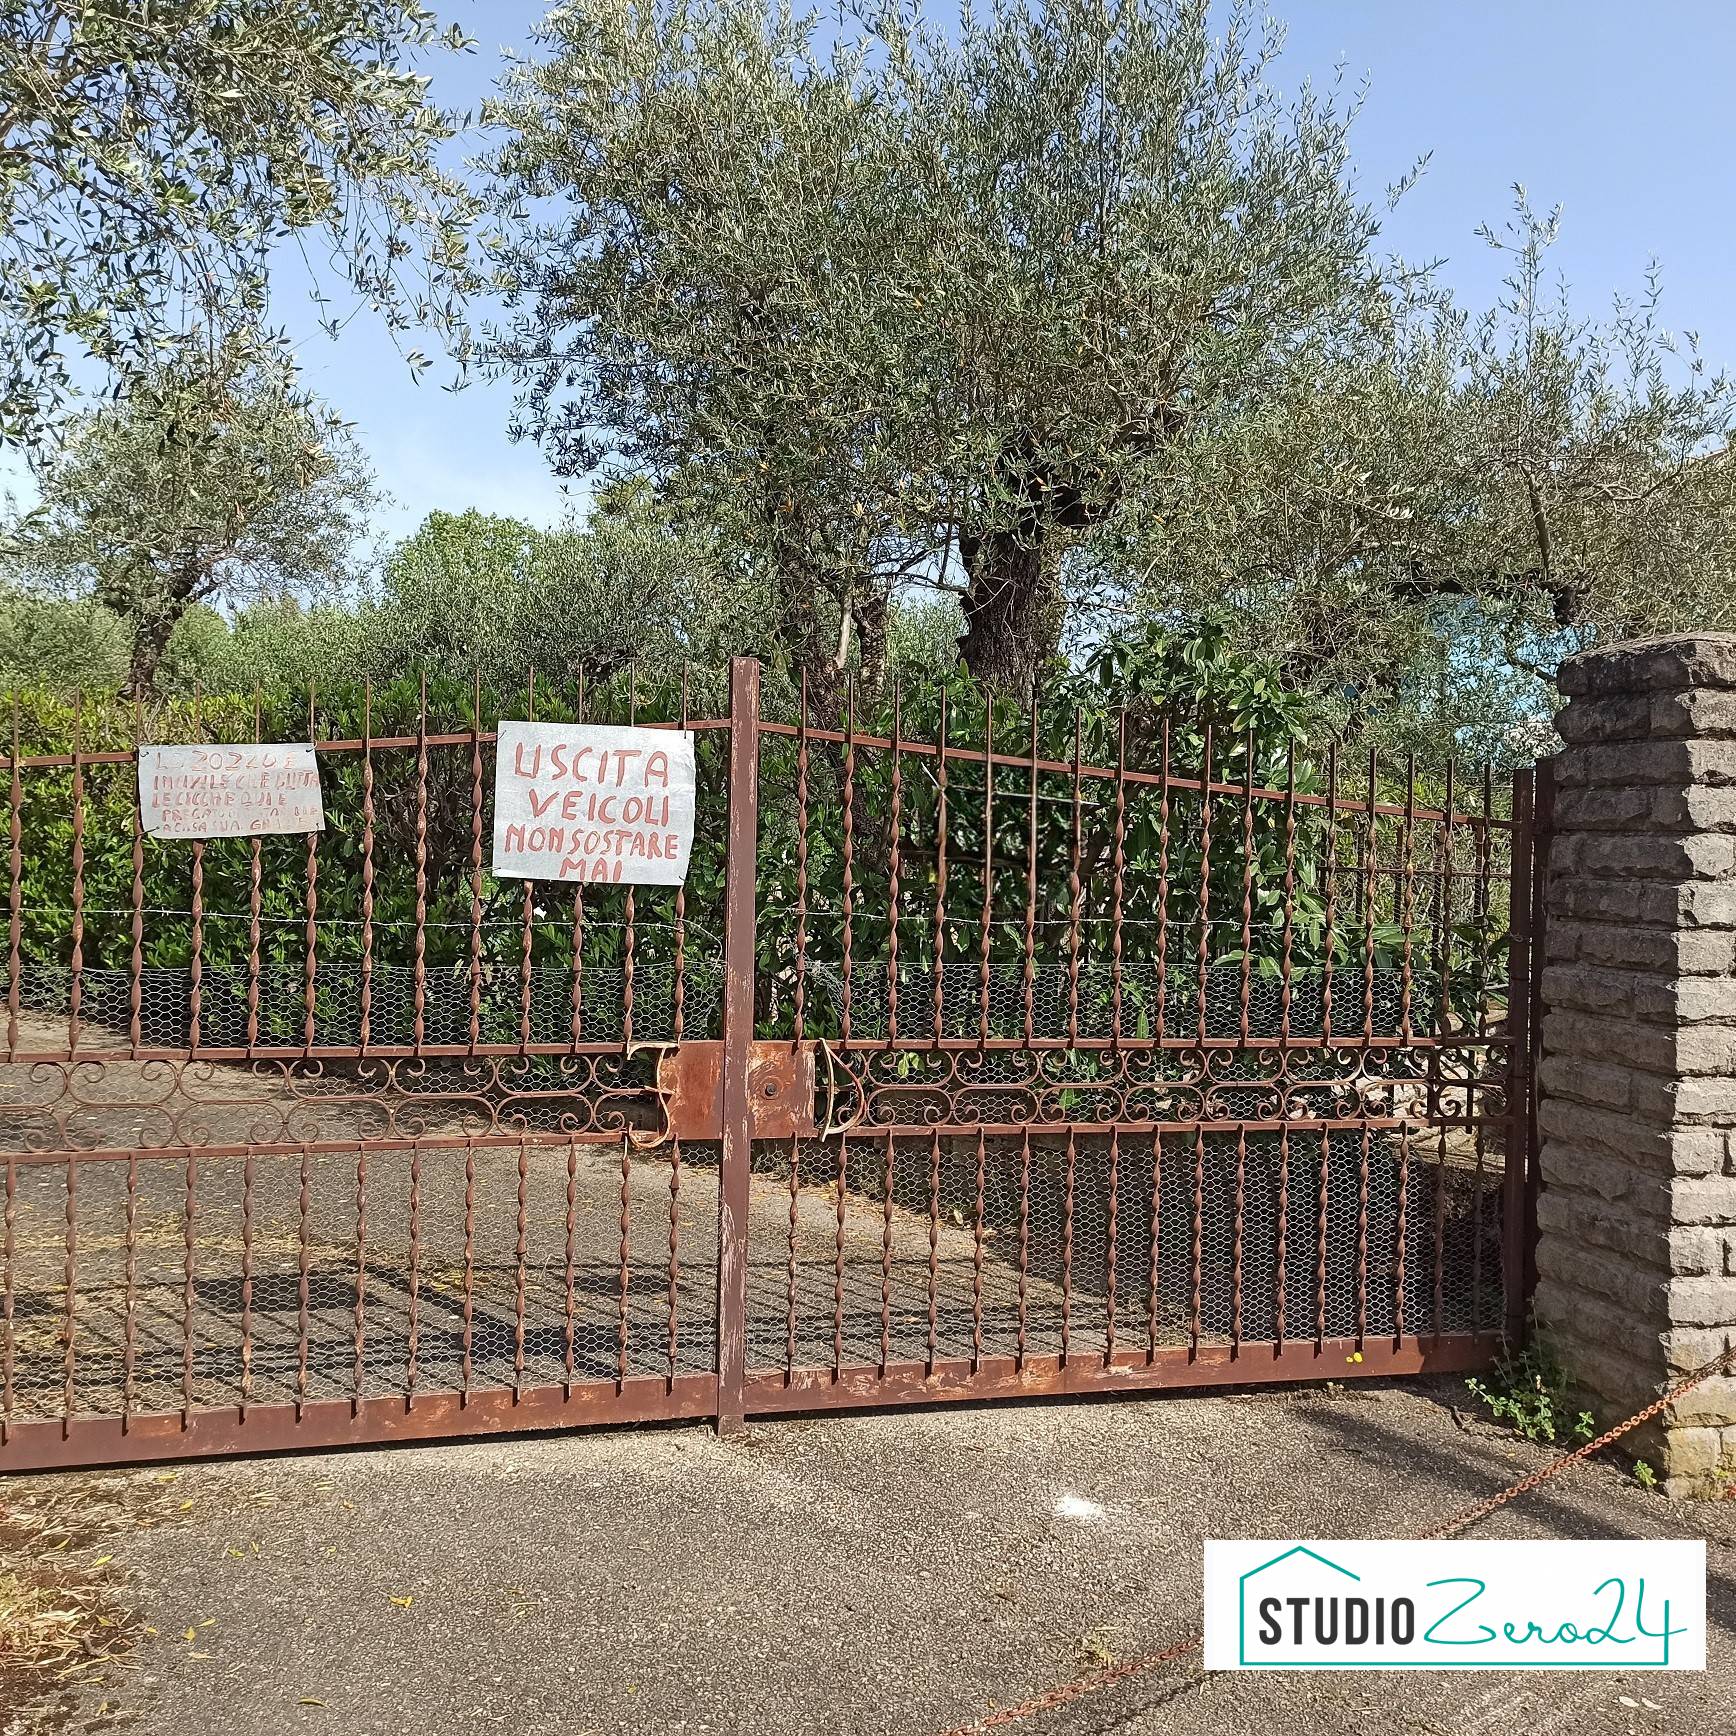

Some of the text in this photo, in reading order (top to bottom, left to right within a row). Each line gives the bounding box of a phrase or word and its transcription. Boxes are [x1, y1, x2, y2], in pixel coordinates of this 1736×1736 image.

[514, 742, 669, 788] USCITA
[528, 788, 669, 827] VEICOLI
[504, 823, 679, 860] NON SOSTARE
[559, 857, 623, 882] MAI
